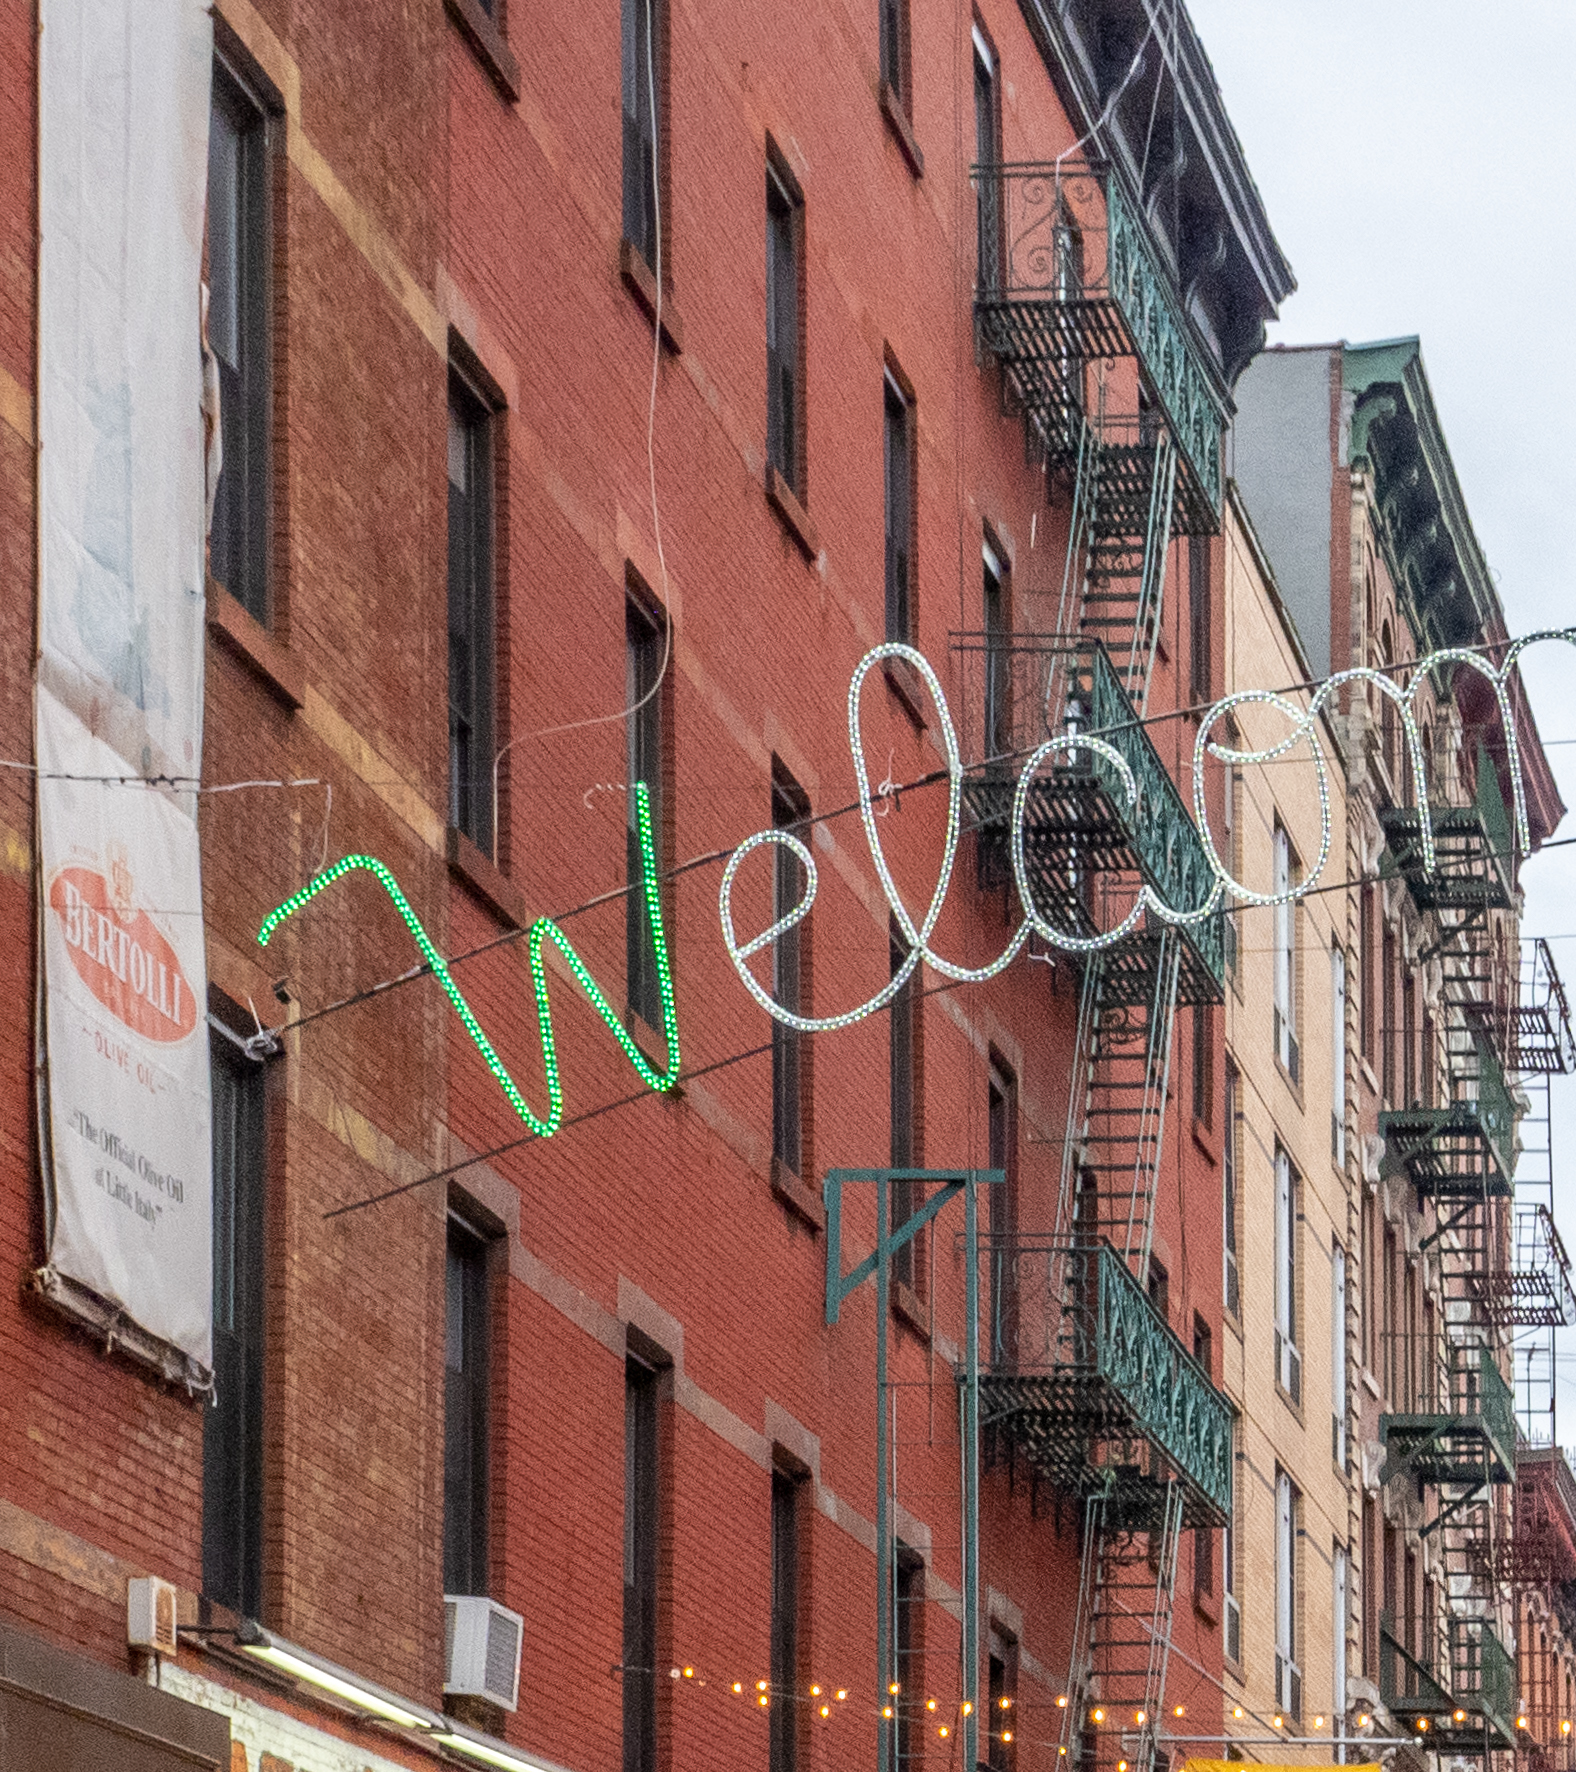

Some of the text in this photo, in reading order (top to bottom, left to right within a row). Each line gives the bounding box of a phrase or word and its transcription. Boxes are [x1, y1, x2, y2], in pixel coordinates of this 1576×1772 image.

[65, 879, 181, 1026] BERTOLLI
[95, 1030, 156, 1094] OLIVE OIL
[166, 1174, 184, 1203] Oil
